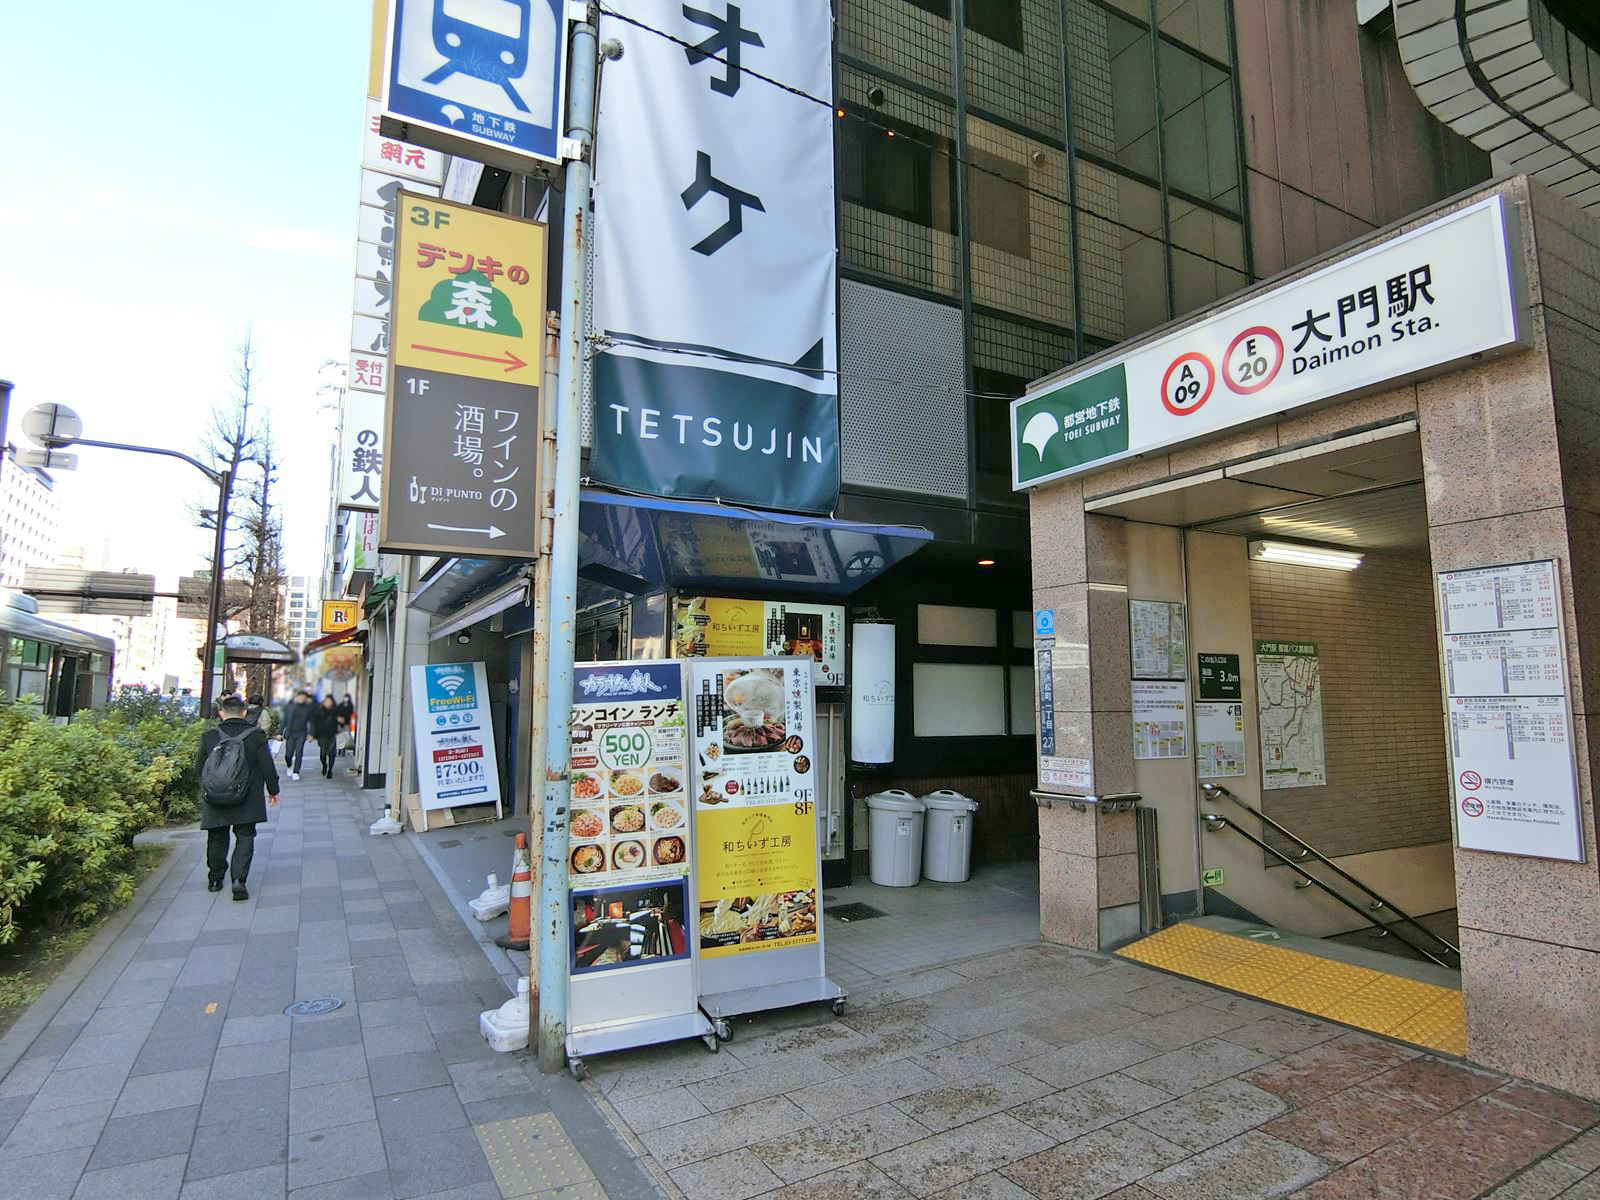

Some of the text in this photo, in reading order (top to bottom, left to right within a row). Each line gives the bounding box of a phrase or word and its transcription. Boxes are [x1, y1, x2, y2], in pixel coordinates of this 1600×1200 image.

[472, 111, 516, 133] 地下鉄
[472, 124, 516, 143] SUBWAY
[410, 207, 450, 229] 3F
[417, 242, 530, 285] デンキの
[444, 281, 497, 329] 森
[1291, 264, 1435, 353] 大門駅
[1246, 339, 1256, 357] E
[1293, 313, 1440, 376] Daimon Sta.
[355, 359, 383, 374] 受付
[1180, 364, 1194, 382] A
[1238, 356, 1268, 383] 20
[354, 373, 383, 387] 入口
[406, 378, 430, 395] 1F
[1175, 380, 1201, 404] 09
[1064, 396, 1121, 429] 都営地下鉄
[609, 403, 822, 464] TETSUJIN
[1064, 413, 1121, 442] TOEI SUBWAY
[453, 403, 486, 477] 酒場。
[351, 429, 382, 503] の鉄人
[490, 409, 519, 511] ワインの
[447, 488, 482, 500] PUNTO
[579, 669, 662, 697] カラオケの鉄人
[827, 672, 843, 685] 9F
[640, 703, 679, 719] ランチ
[606, 733, 645, 753] 500
[1042, 737, 1053, 748] 27
[443, 761, 479, 777] 7:00
[613, 753, 640, 766] YEN
[1484, 777, 1514, 786] 構内禁煙
[794, 788, 812, 802] 9F
[794, 801, 813, 816] 8F
[723, 834, 792, 853] 和ちいず工房
